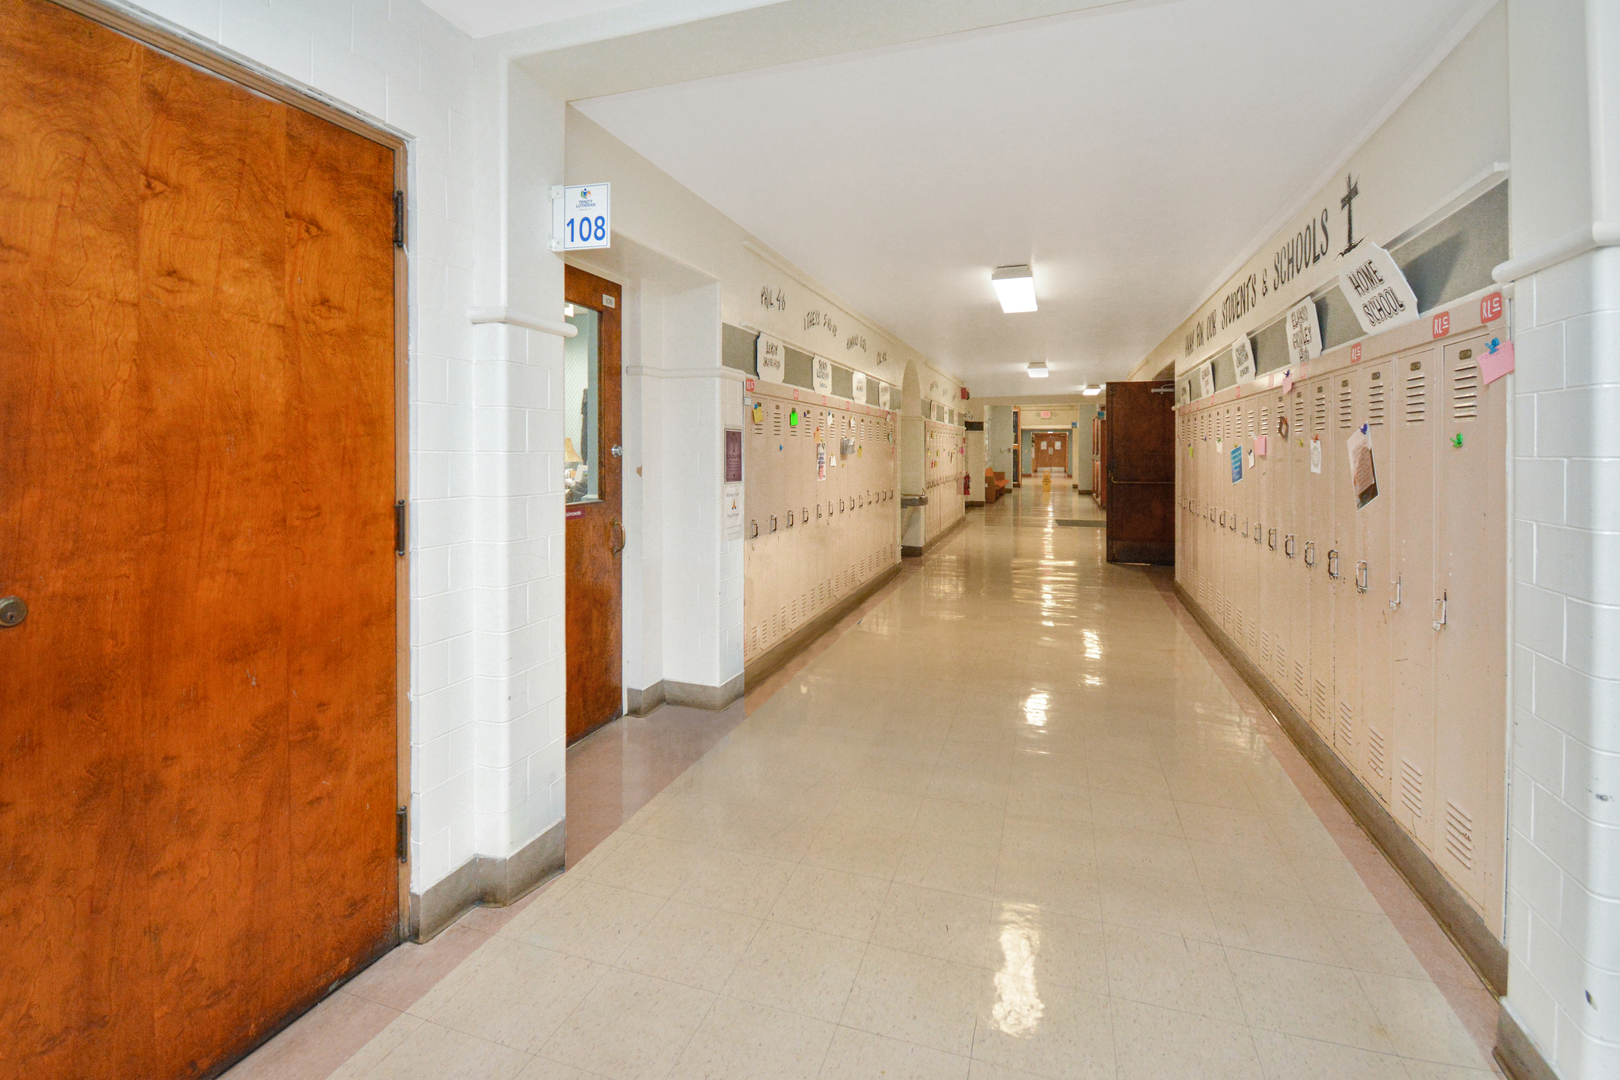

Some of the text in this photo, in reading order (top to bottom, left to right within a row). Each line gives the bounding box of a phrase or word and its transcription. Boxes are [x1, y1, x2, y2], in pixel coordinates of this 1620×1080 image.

[566, 215, 606, 242] 108
[1222, 273, 1257, 330] STUDENTS
[1262, 267, 1268, 297] &
[1273, 207, 1329, 292] SCHOOLS
[1347, 259, 1384, 297] HOME
[1362, 286, 1405, 327] SCHOOL
